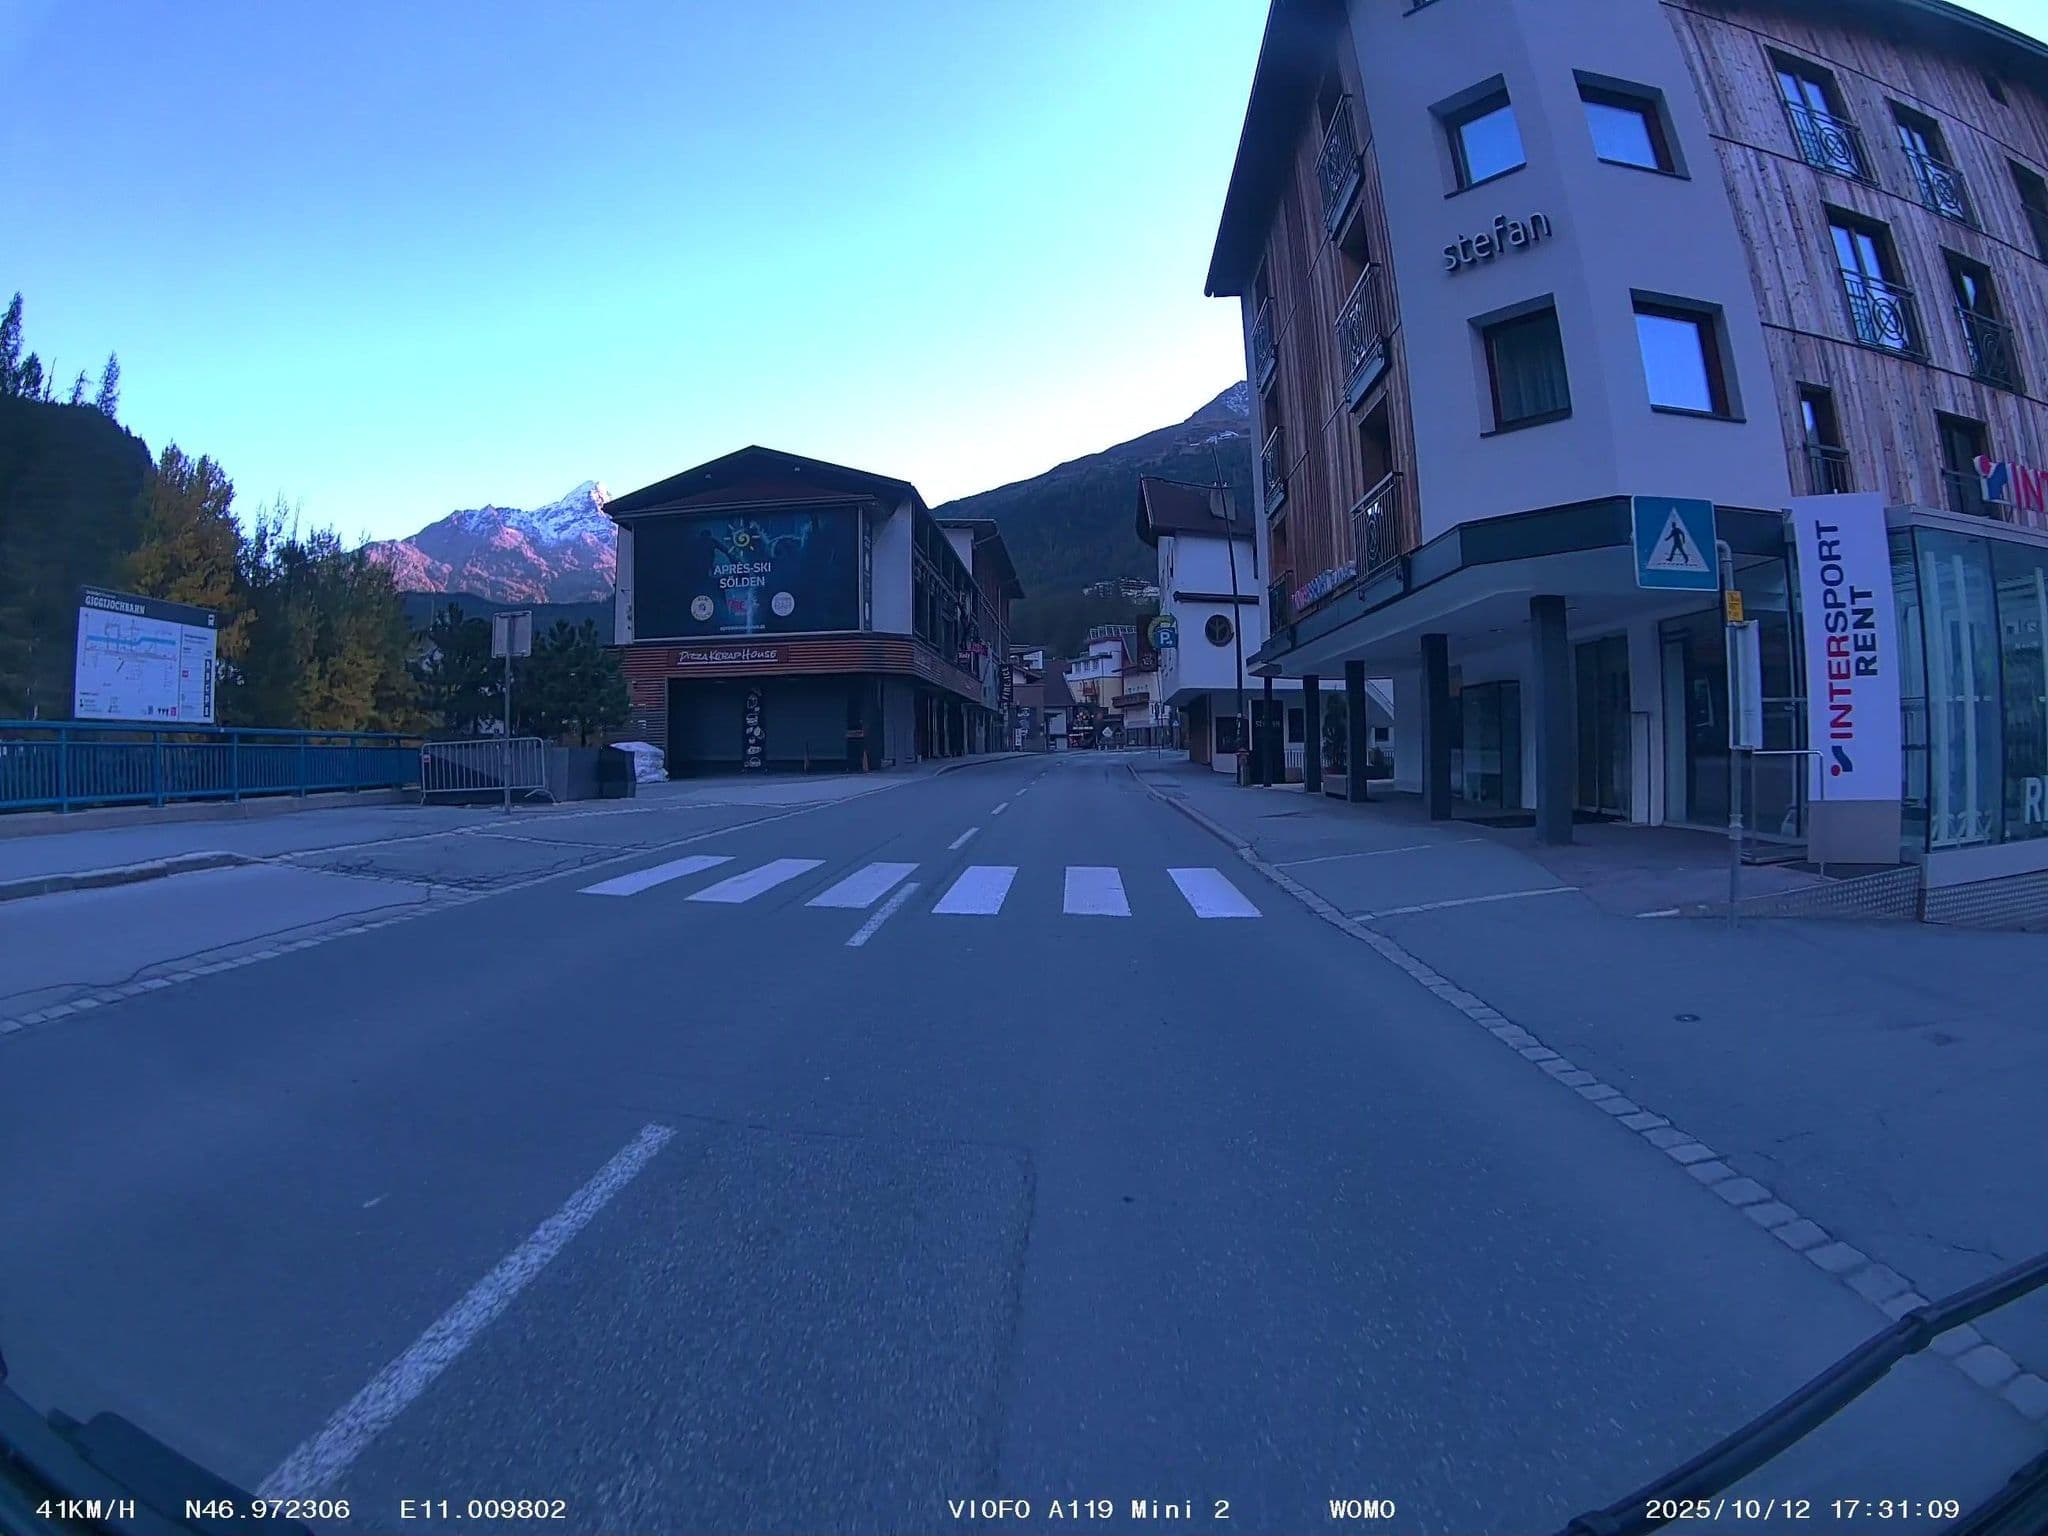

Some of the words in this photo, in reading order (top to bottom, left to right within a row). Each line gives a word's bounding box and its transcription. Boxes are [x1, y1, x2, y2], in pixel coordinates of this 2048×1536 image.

[1442, 211, 1552, 272] stefan
[720, 575, 765, 588] SÖLDEN
[1160, 632, 1170, 644] P
[1815, 520, 1854, 739] INTERSPORT
[1849, 586, 1878, 677] RENT
